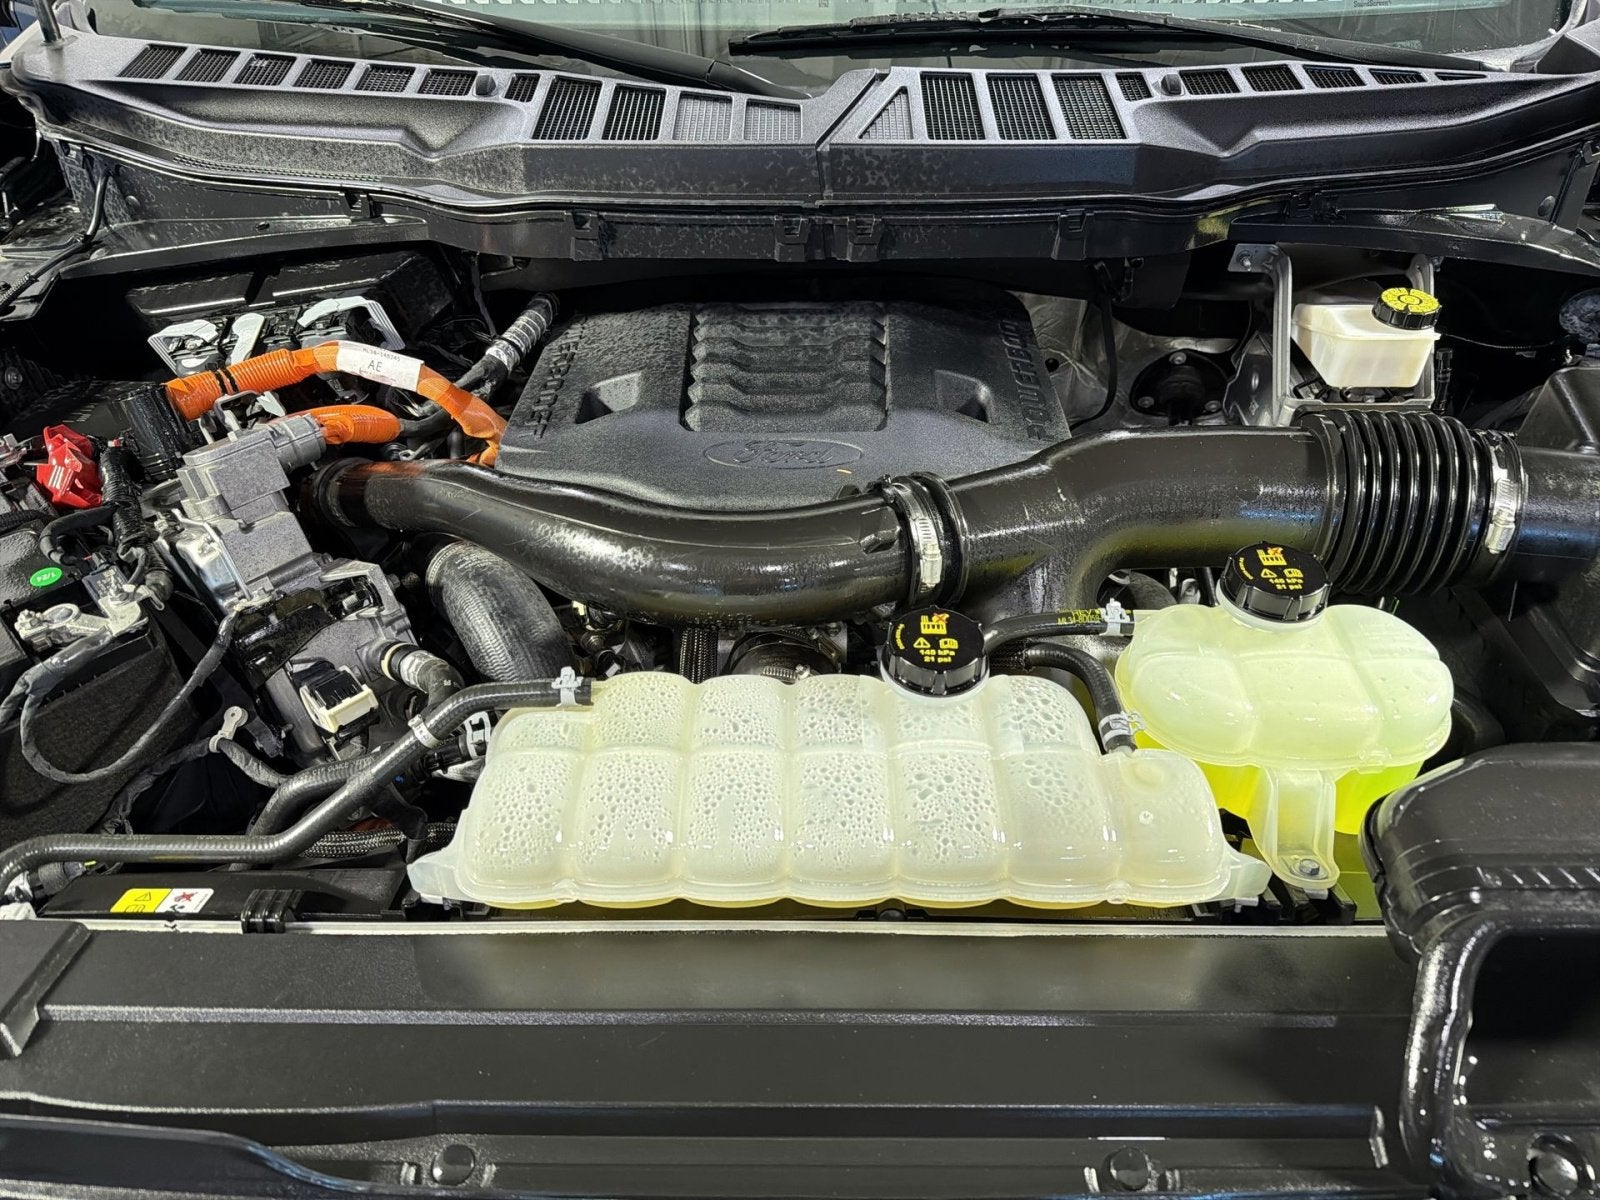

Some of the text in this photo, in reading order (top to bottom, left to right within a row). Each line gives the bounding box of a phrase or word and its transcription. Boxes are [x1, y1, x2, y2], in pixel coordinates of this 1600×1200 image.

[367, 359, 383, 373] AE
[518, 313, 588, 440] OWERBOOST
[732, 440, 835, 464] Ford
[937, 656, 952, 664] psi
